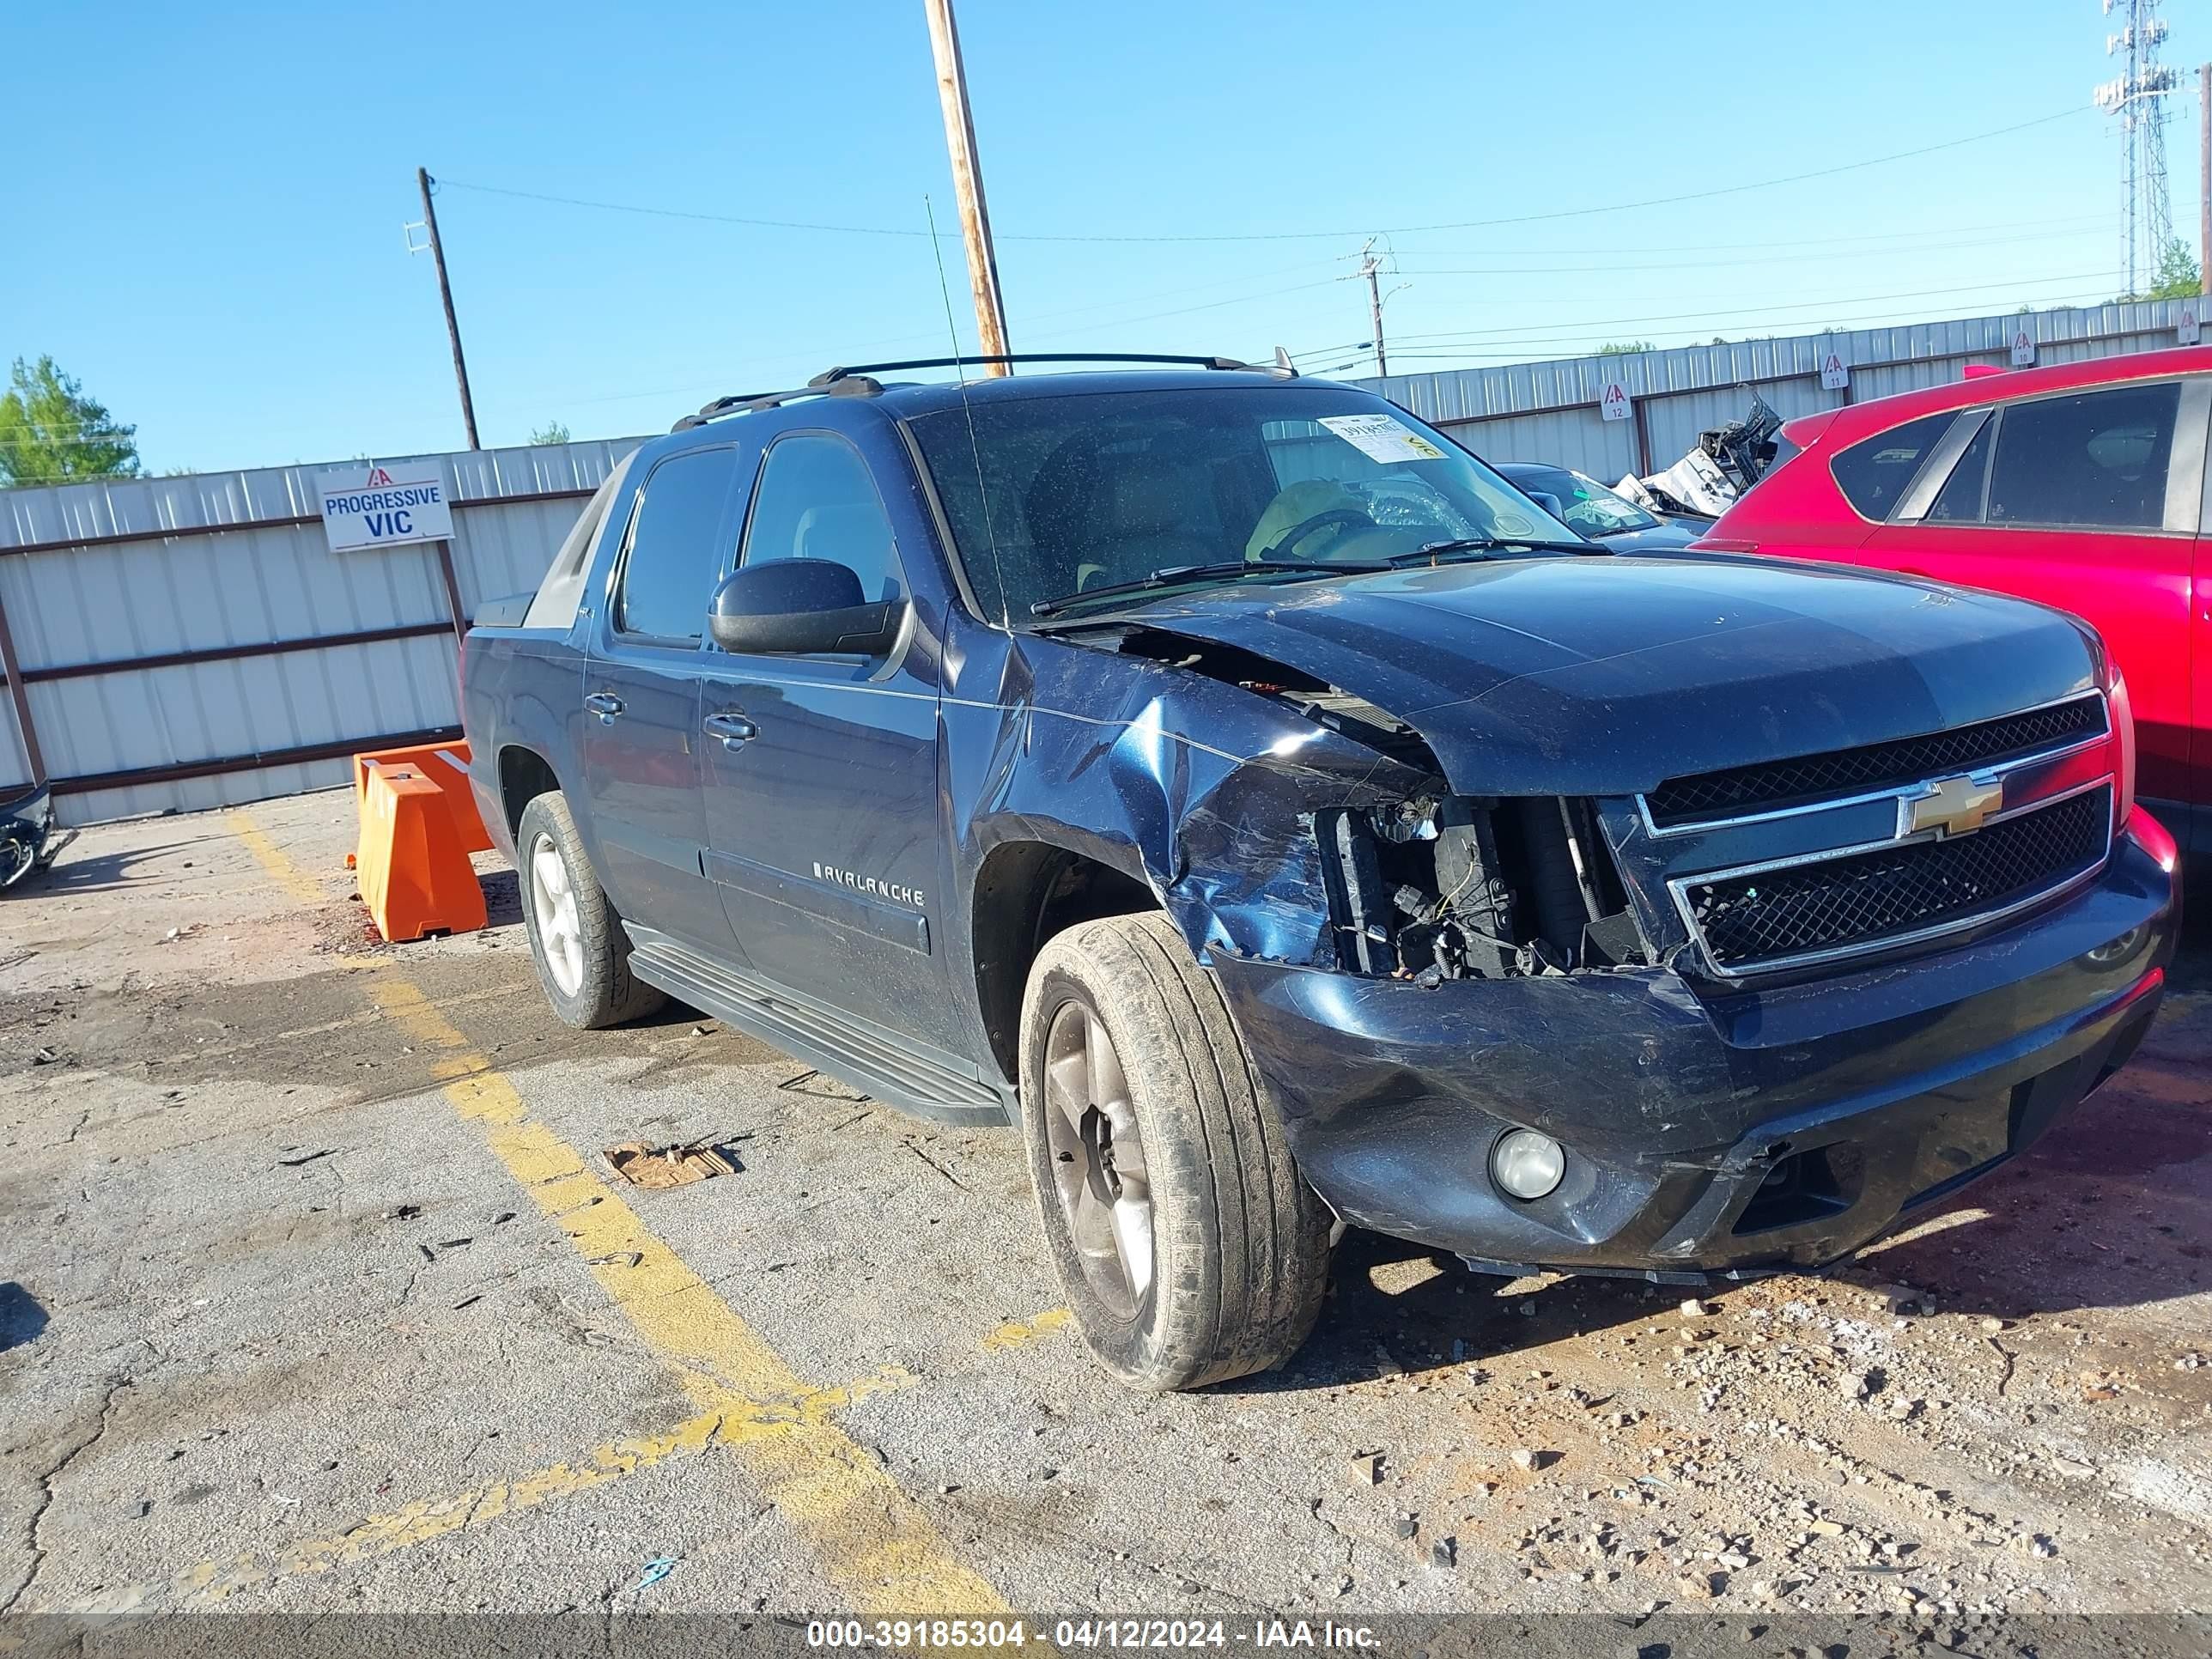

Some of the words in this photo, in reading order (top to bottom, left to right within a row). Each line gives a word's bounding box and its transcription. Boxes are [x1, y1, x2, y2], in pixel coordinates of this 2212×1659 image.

[2020, 354, 2027, 363] 10
[1831, 378, 1840, 386] 11
[1613, 408, 1623, 418] 12
[1408, 436, 1439, 457] VIC
[325, 487, 441, 516] PROGRESSIVE
[364, 510, 413, 538] VIC
[824, 865, 925, 907] AVALANCHE
